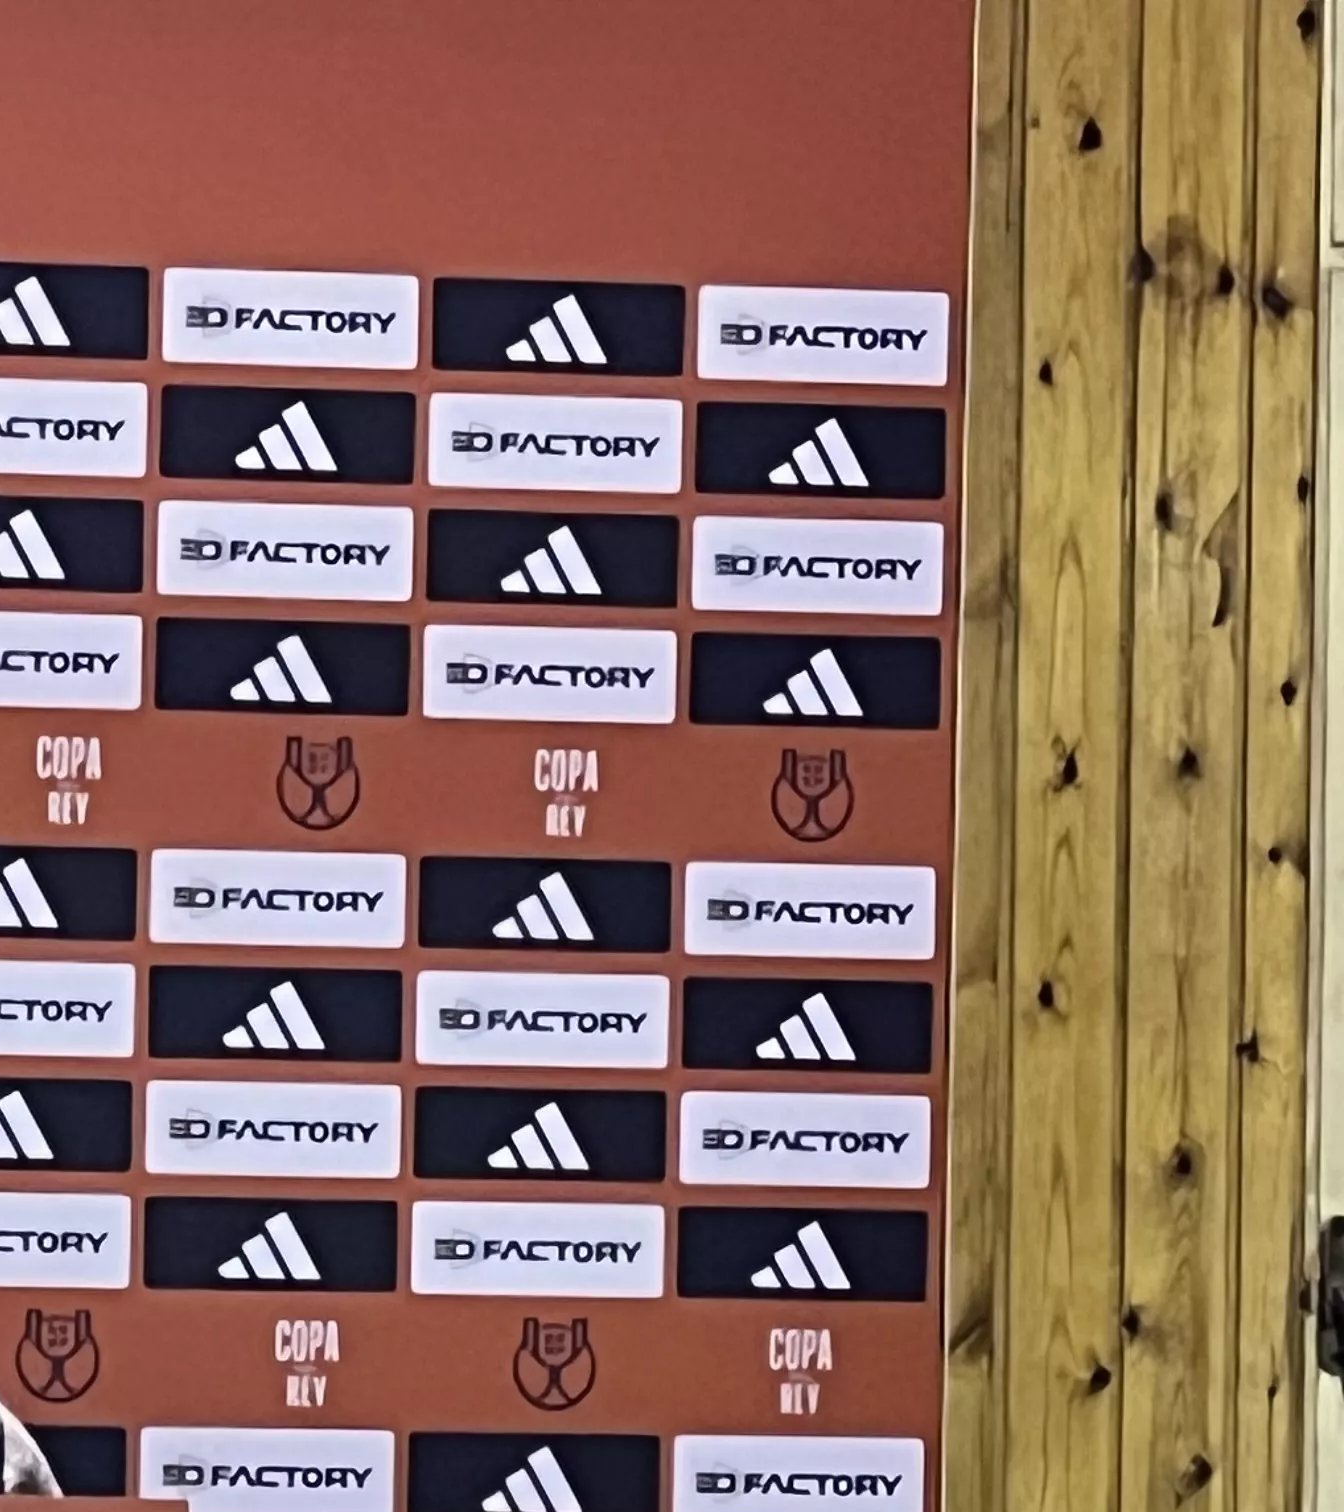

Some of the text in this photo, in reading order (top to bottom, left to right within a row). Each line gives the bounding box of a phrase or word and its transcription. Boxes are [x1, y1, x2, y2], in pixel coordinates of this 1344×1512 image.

[235, 308, 396, 334] FACTORY
[769, 325, 928, 350] FACTORY
[500, 433, 660, 457] FACTORY
[230, 540, 390, 565] FACTORY
[763, 556, 922, 580] FACTORY
[495, 664, 655, 688] FACTORY
[37, 736, 101, 779] COPA
[535, 749, 598, 791] COPA
[222, 888, 383, 912] FACTORY
[754, 901, 914, 925] FACTORY
[487, 1010, 647, 1033] FACTORY
[217, 1120, 378, 1143] FACTORY
[748, 1130, 909, 1153] FACTORY
[483, 1240, 641, 1263] FACTORY
[275, 1320, 339, 1361] COPA
[770, 1329, 832, 1370] COPA
[211, 1466, 372, 1488] FACTORY
[743, 1473, 902, 1496] FACTORY
